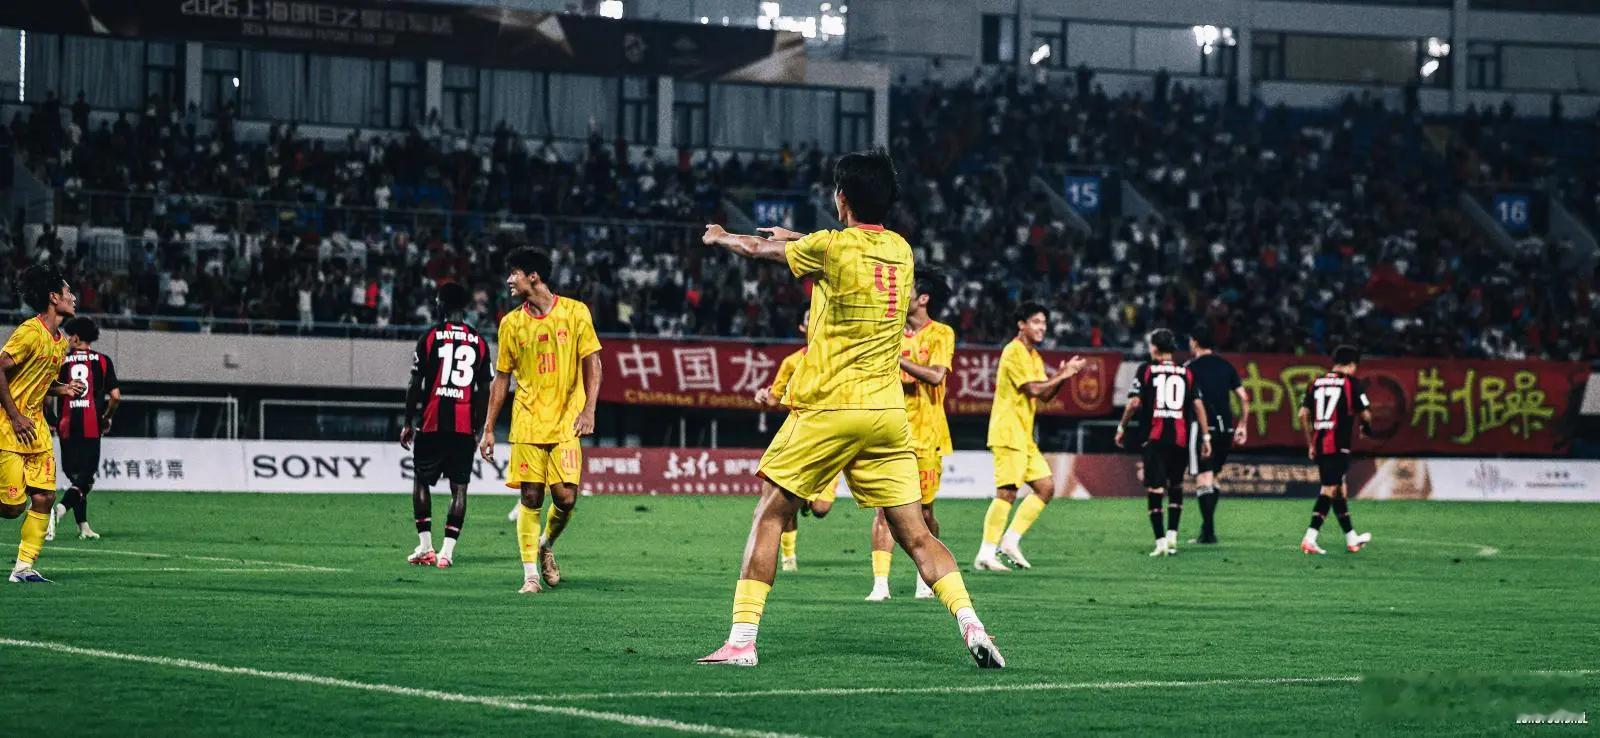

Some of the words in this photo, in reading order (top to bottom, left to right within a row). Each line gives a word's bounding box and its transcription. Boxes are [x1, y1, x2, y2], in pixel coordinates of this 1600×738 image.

[1070, 183, 1098, 208] 15
[1497, 201, 1527, 224] 16
[436, 331, 466, 342] BAYER
[467, 333, 479, 344] 04
[438, 343, 476, 387] 13
[536, 351, 556, 374] 20
[616, 344, 776, 392] 中国龙
[1153, 373, 1186, 410] 10
[1313, 386, 1342, 420] 17
[96, 458, 184, 480] 体育彩票
[253, 454, 371, 479] SONY
[560, 449, 578, 469] 20
